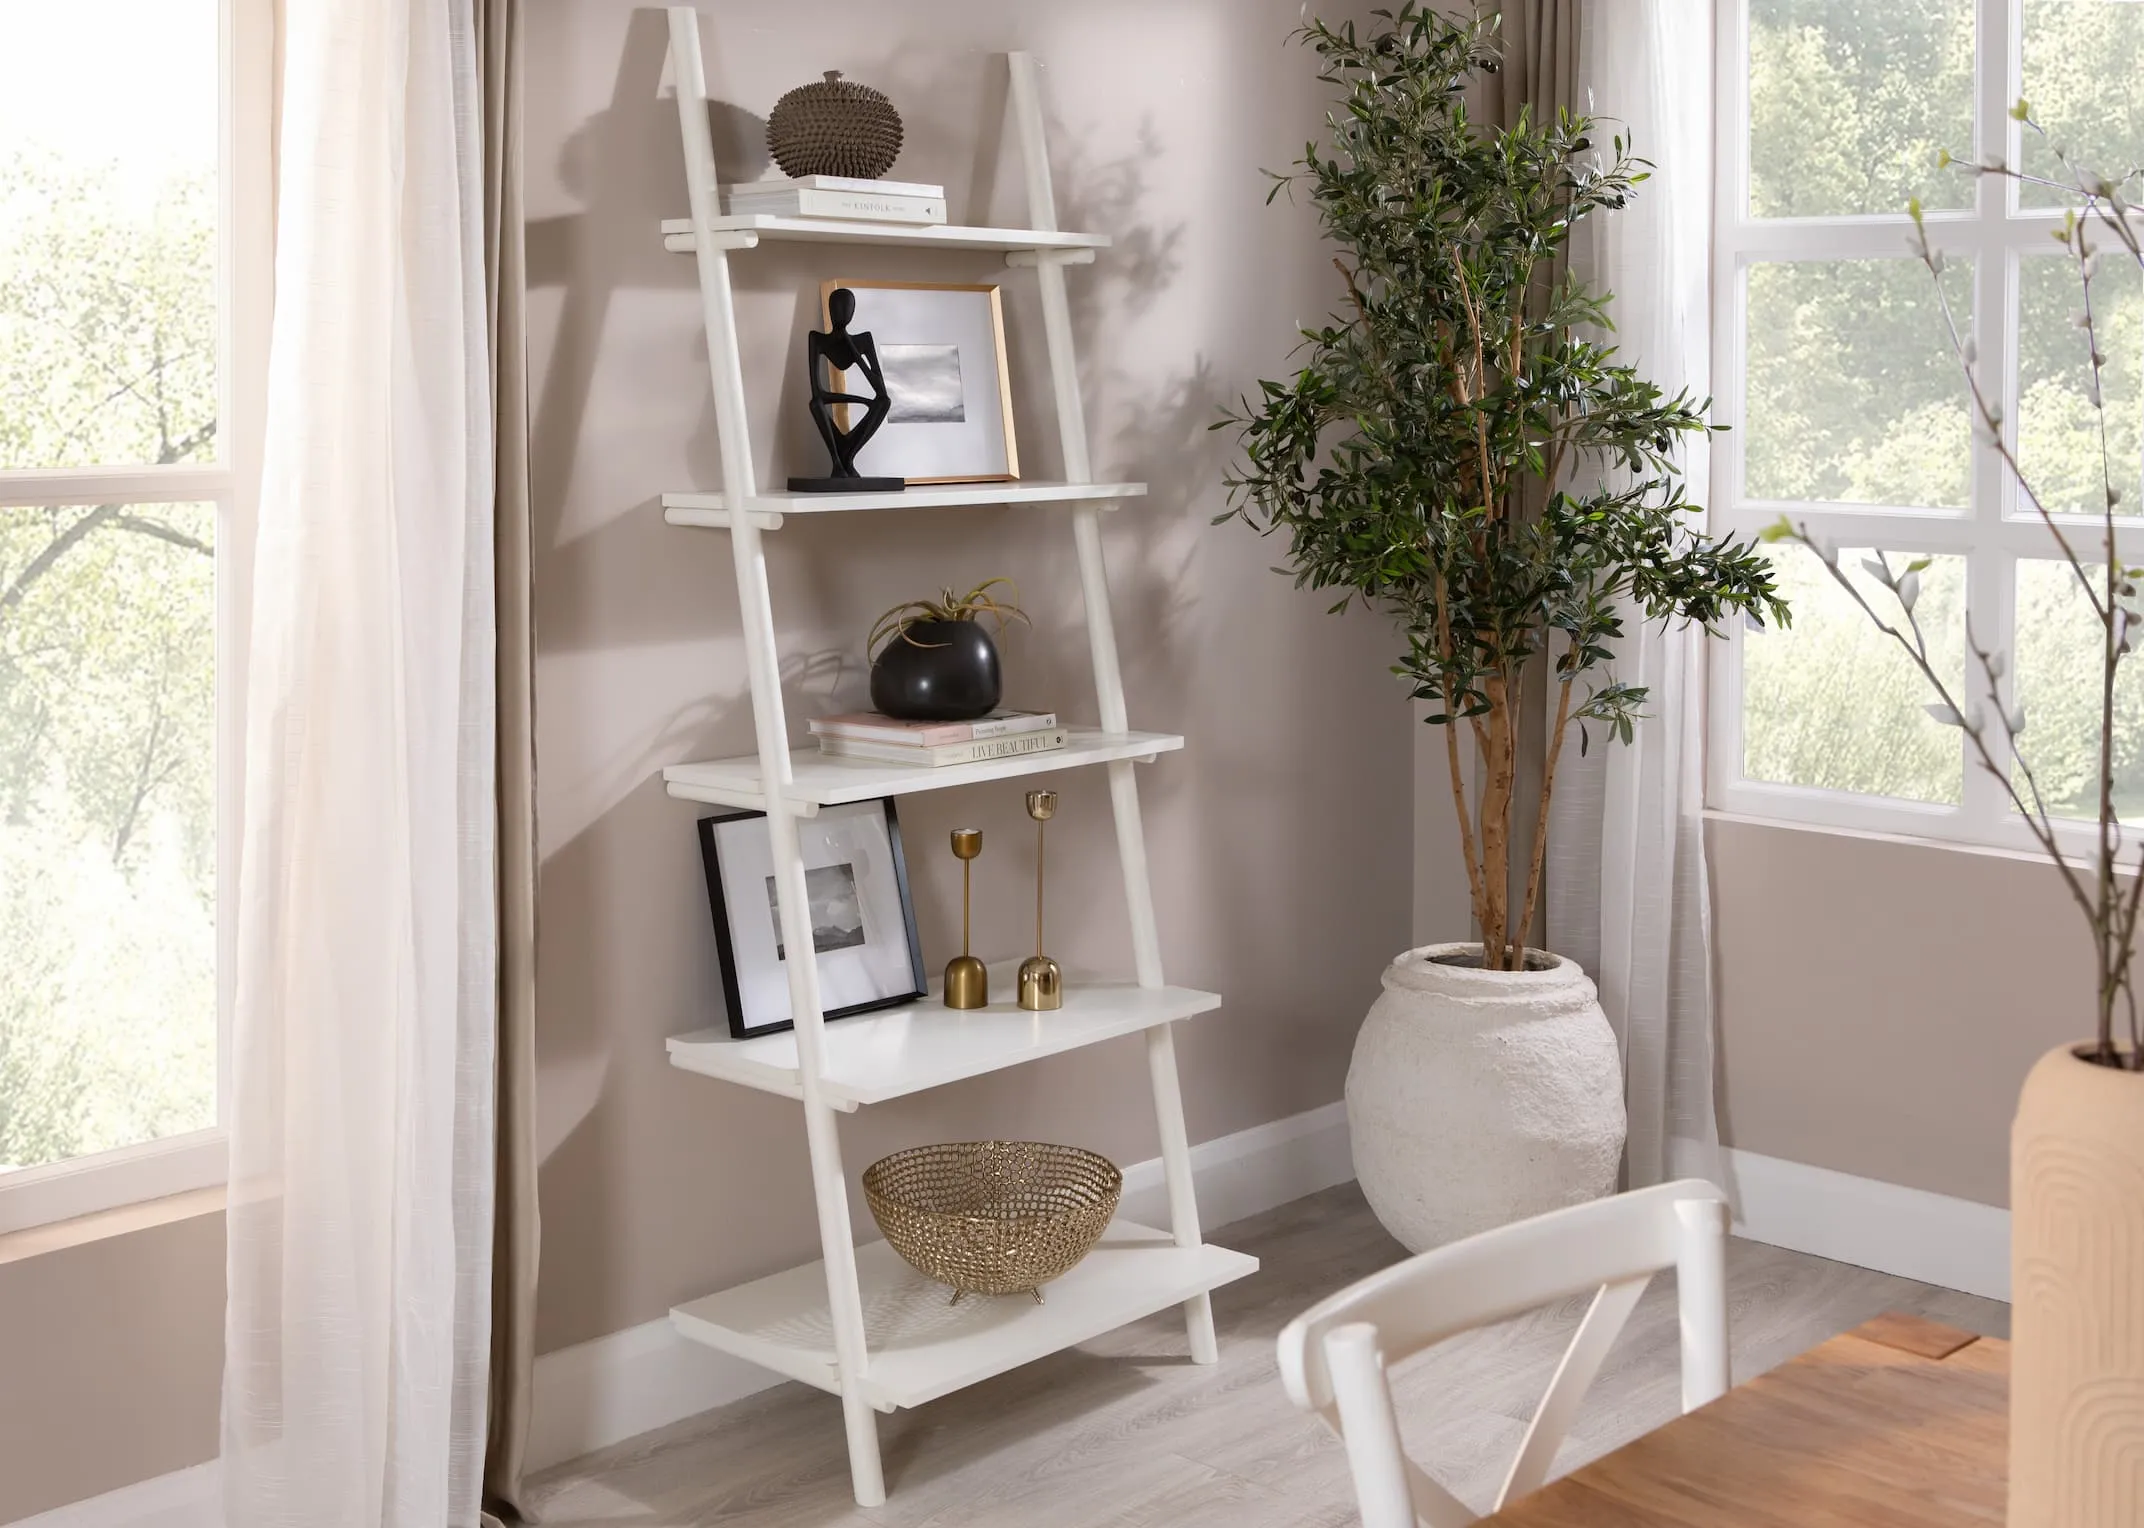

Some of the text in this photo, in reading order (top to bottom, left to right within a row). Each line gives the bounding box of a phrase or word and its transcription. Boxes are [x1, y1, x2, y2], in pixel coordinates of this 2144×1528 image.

[854, 202, 891, 212] KINFOLK
[971, 743, 995, 759] LIVE
[996, 735, 1048, 755] BEAUTIFUL
